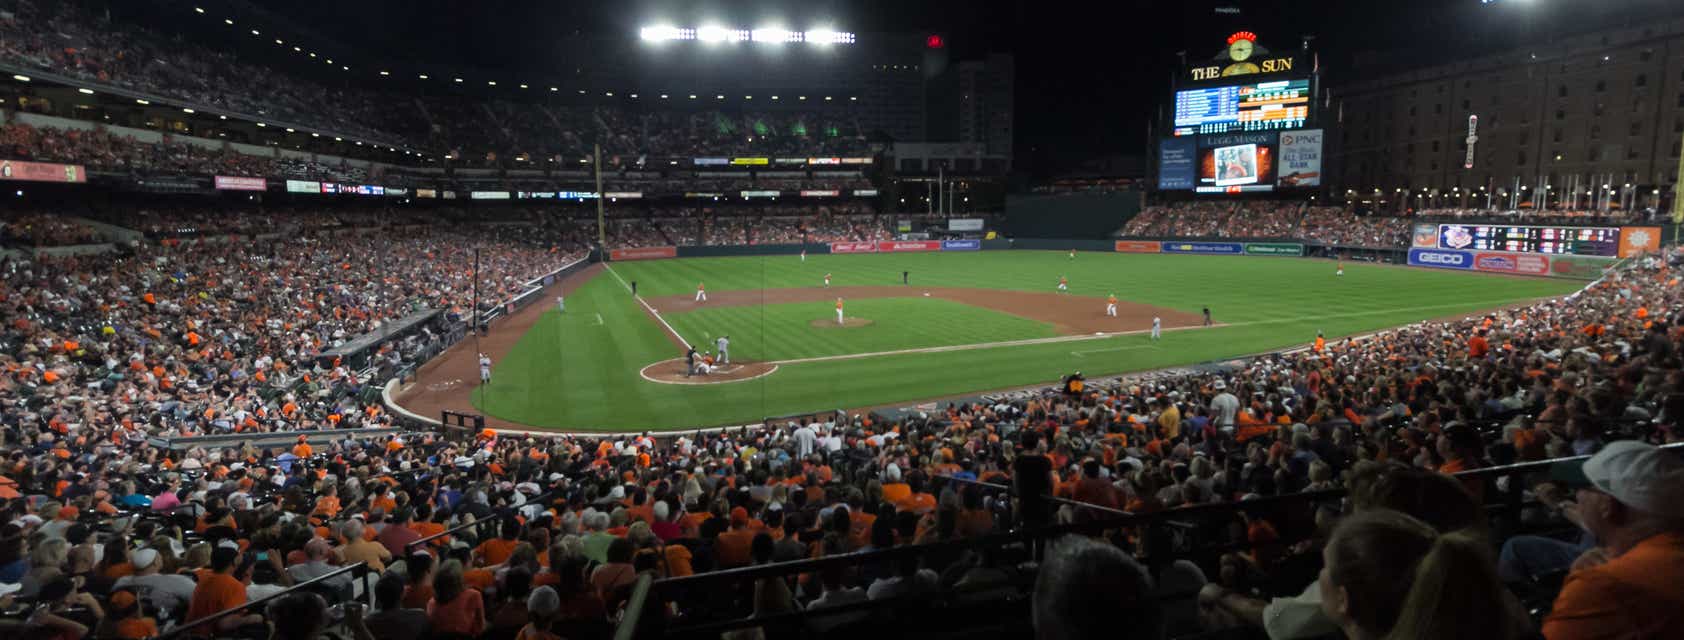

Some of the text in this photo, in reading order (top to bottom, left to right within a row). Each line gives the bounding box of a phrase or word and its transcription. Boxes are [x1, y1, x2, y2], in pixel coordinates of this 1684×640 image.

[1192, 57, 1293, 80] THE SUN
[1296, 134, 1320, 144] PNC
[1418, 252, 1463, 265] GEICO
